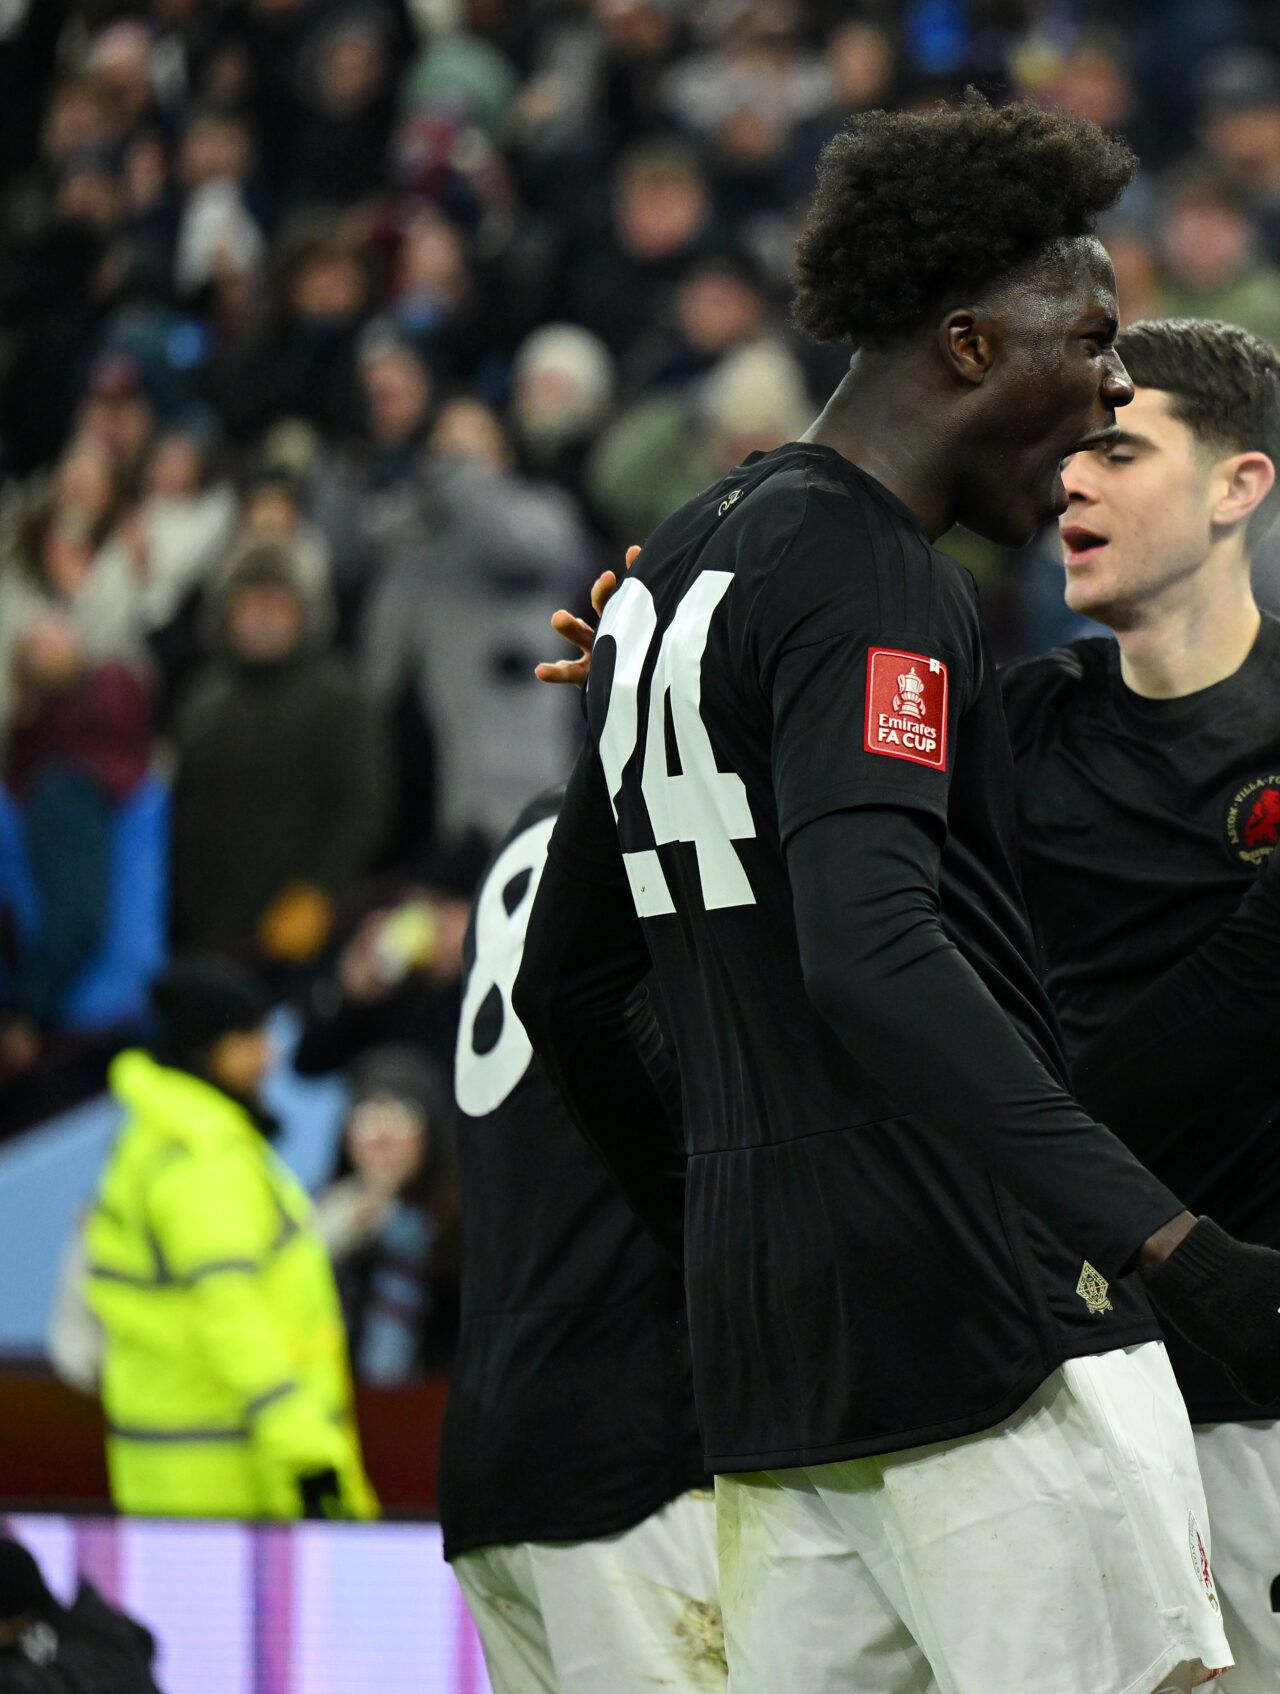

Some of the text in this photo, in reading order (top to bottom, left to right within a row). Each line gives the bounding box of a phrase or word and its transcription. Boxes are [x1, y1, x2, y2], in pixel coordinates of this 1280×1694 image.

[878, 713, 937, 739] Emirates
[586, 569, 757, 918] 24
[878, 727, 937, 753] FA CUP
[1234, 778, 1265, 803] VILLA
[454, 813, 559, 1118] 8
